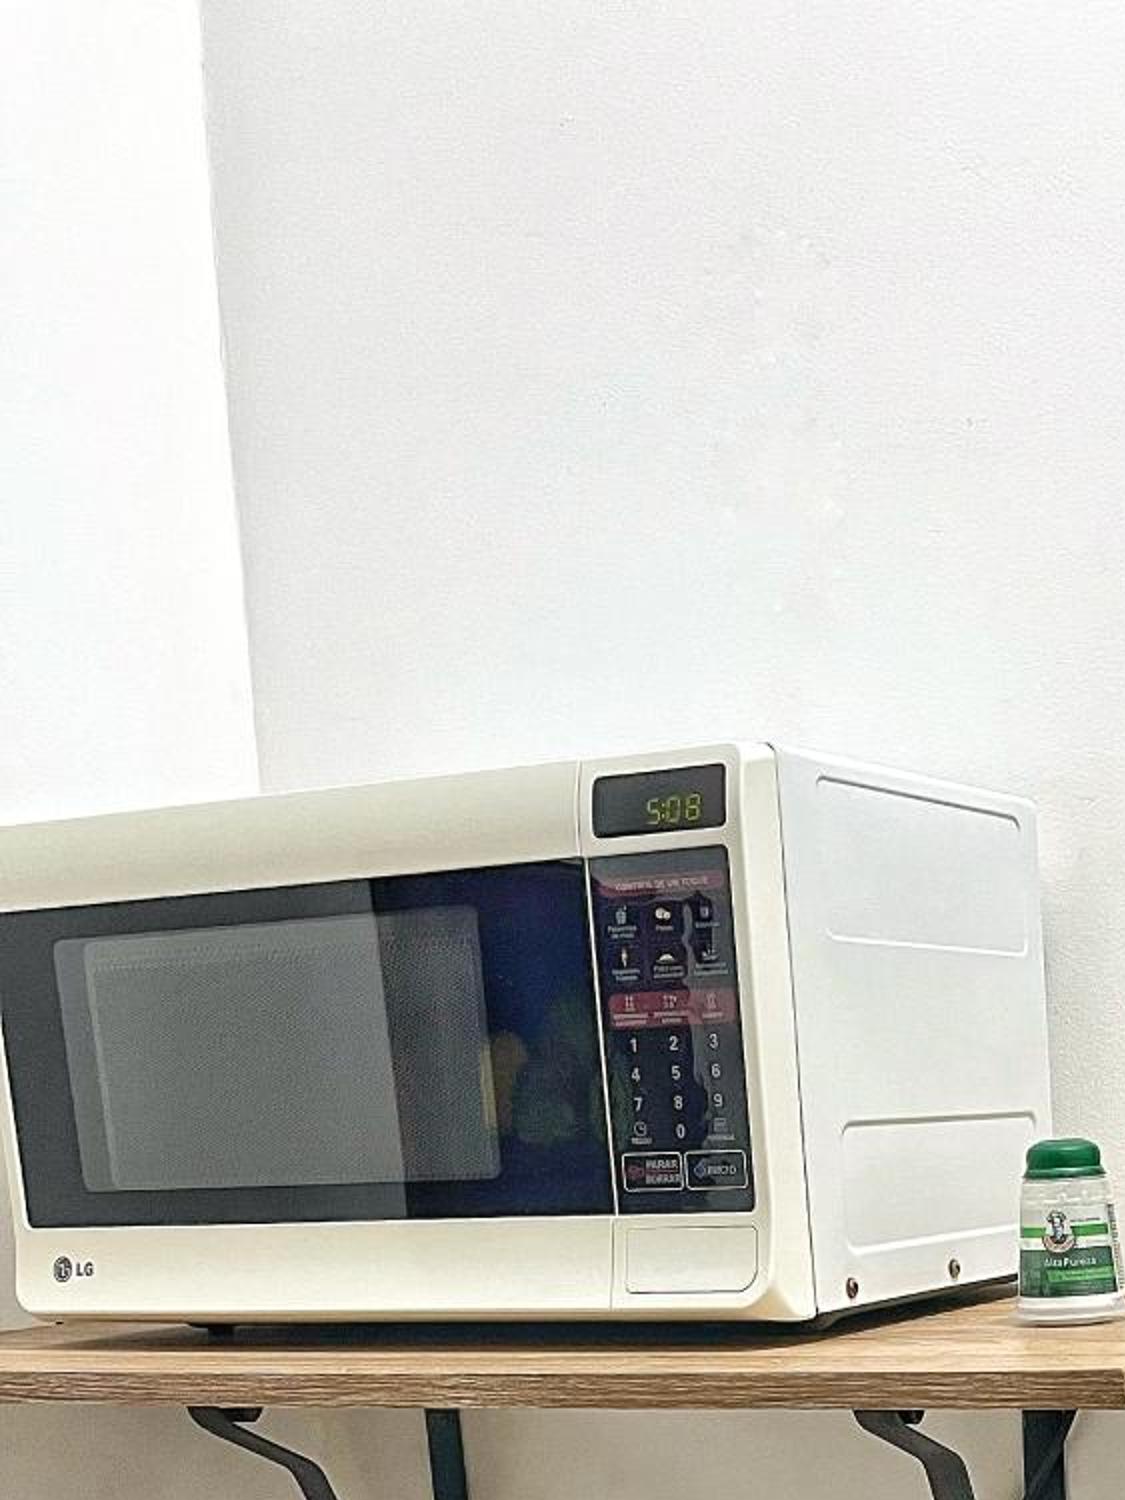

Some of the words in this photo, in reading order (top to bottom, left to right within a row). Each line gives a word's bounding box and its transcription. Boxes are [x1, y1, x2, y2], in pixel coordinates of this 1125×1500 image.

[646, 793, 701, 825] 5:08
[629, 1037, 638, 1053] 1
[669, 1035, 680, 1051] 2
[709, 1033, 719, 1049] 3
[631, 1067, 641, 1082] 4
[671, 1065, 681, 1080] 5
[711, 1063, 721, 1078] 6
[633, 1096, 643, 1111] 7
[673, 1095, 683, 1110] 8
[713, 1093, 723, 1108] 9
[676, 1124, 686, 1139] 0
[75, 1261, 94, 1277] LG
